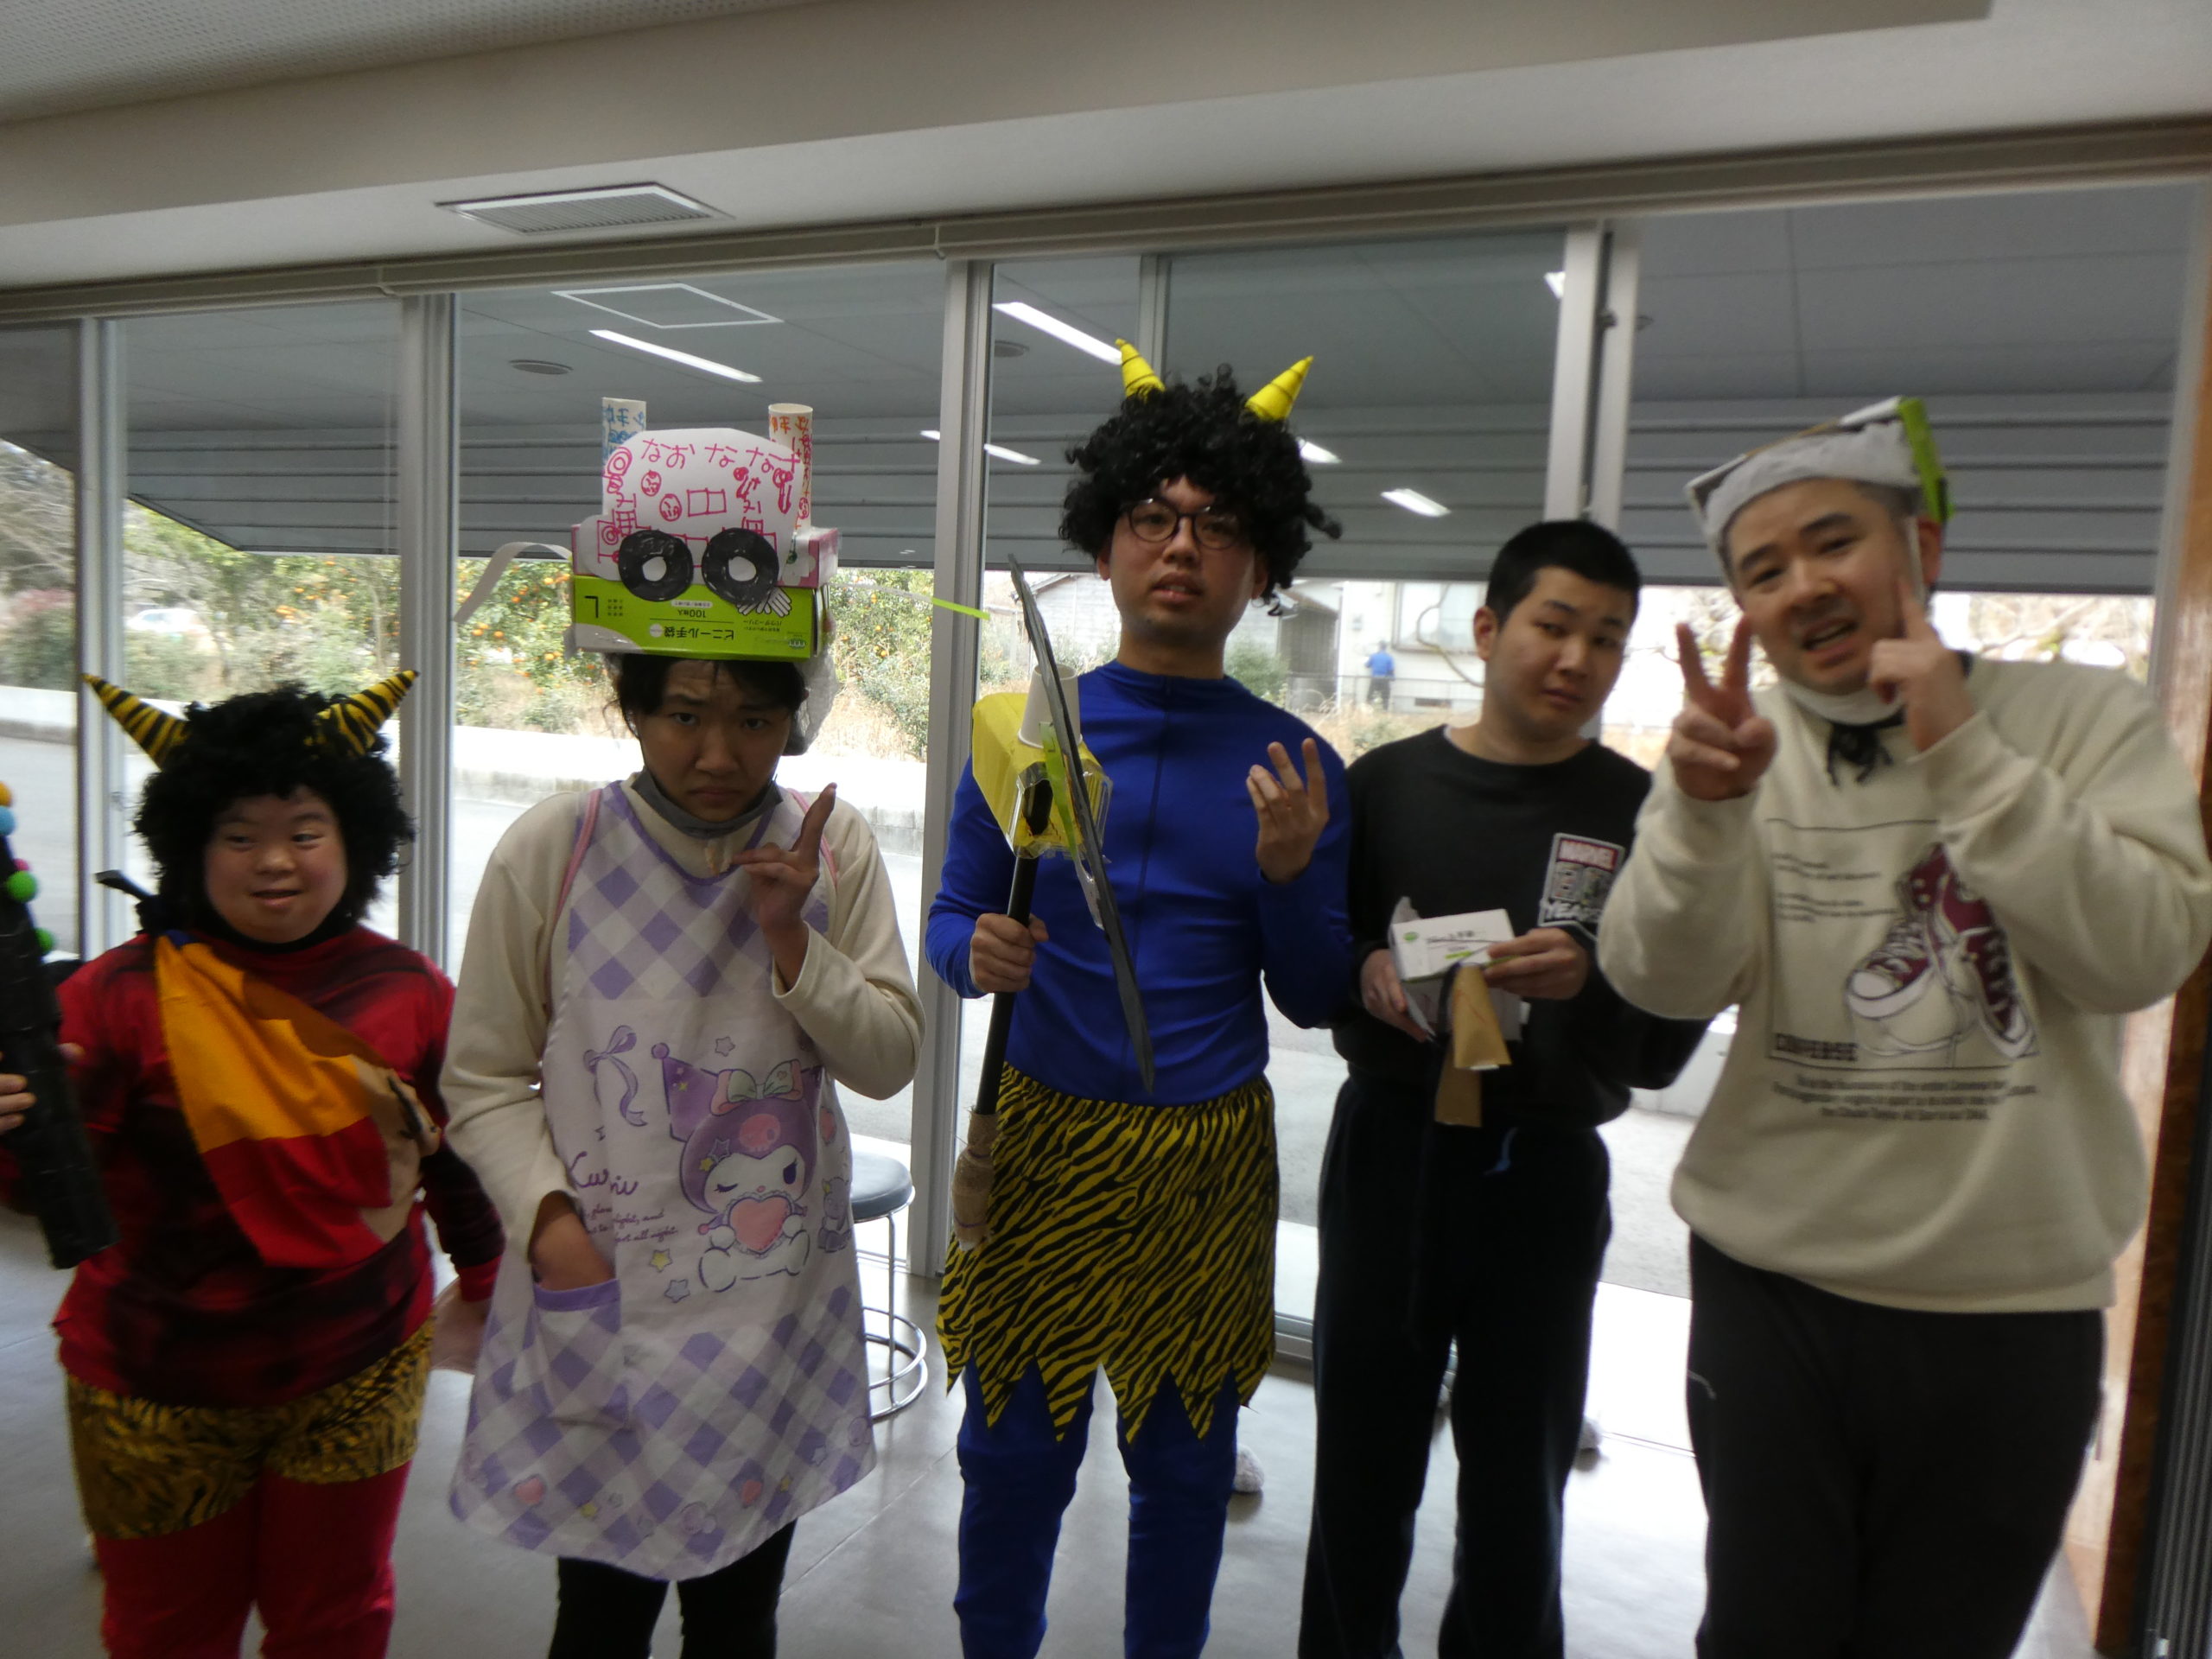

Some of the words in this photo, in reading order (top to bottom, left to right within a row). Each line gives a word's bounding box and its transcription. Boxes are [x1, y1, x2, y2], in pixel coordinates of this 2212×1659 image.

[664, 626, 734, 640] ビニール手袋
